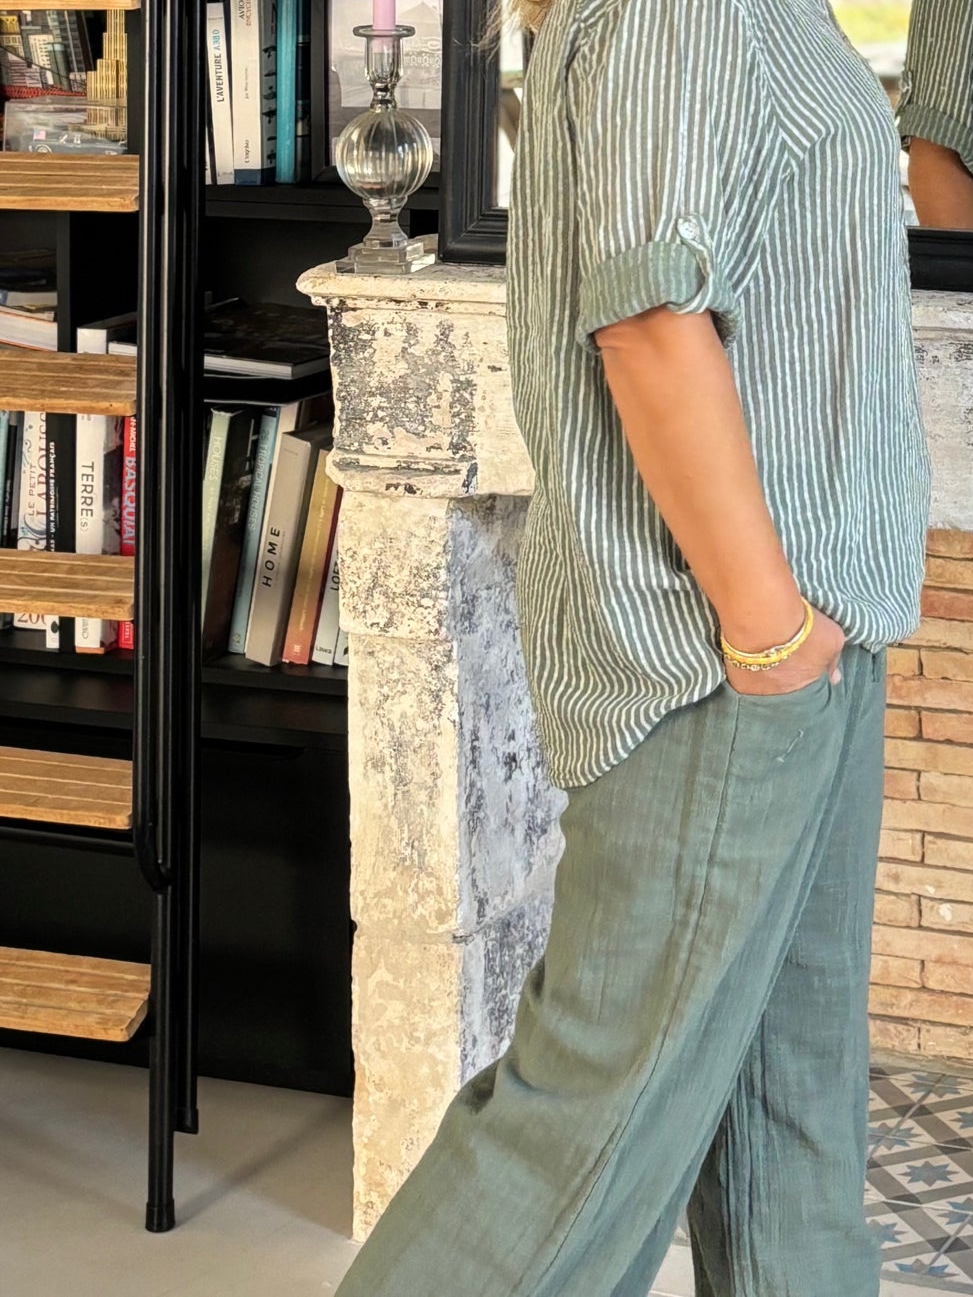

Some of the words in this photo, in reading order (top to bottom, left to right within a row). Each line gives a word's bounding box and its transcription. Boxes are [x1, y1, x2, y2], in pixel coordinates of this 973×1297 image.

[214, 53, 225, 102] L'AVENTURE
[49, 441, 57, 478] FRANÇAIS
[209, 436, 222, 481] HOUSES
[255, 443, 270, 487] TROPICAL
[29, 464, 37, 497] PETIT
[28, 501, 35, 517] LE
[49, 522, 55, 533] UN
[262, 526, 281, 587] HOME
